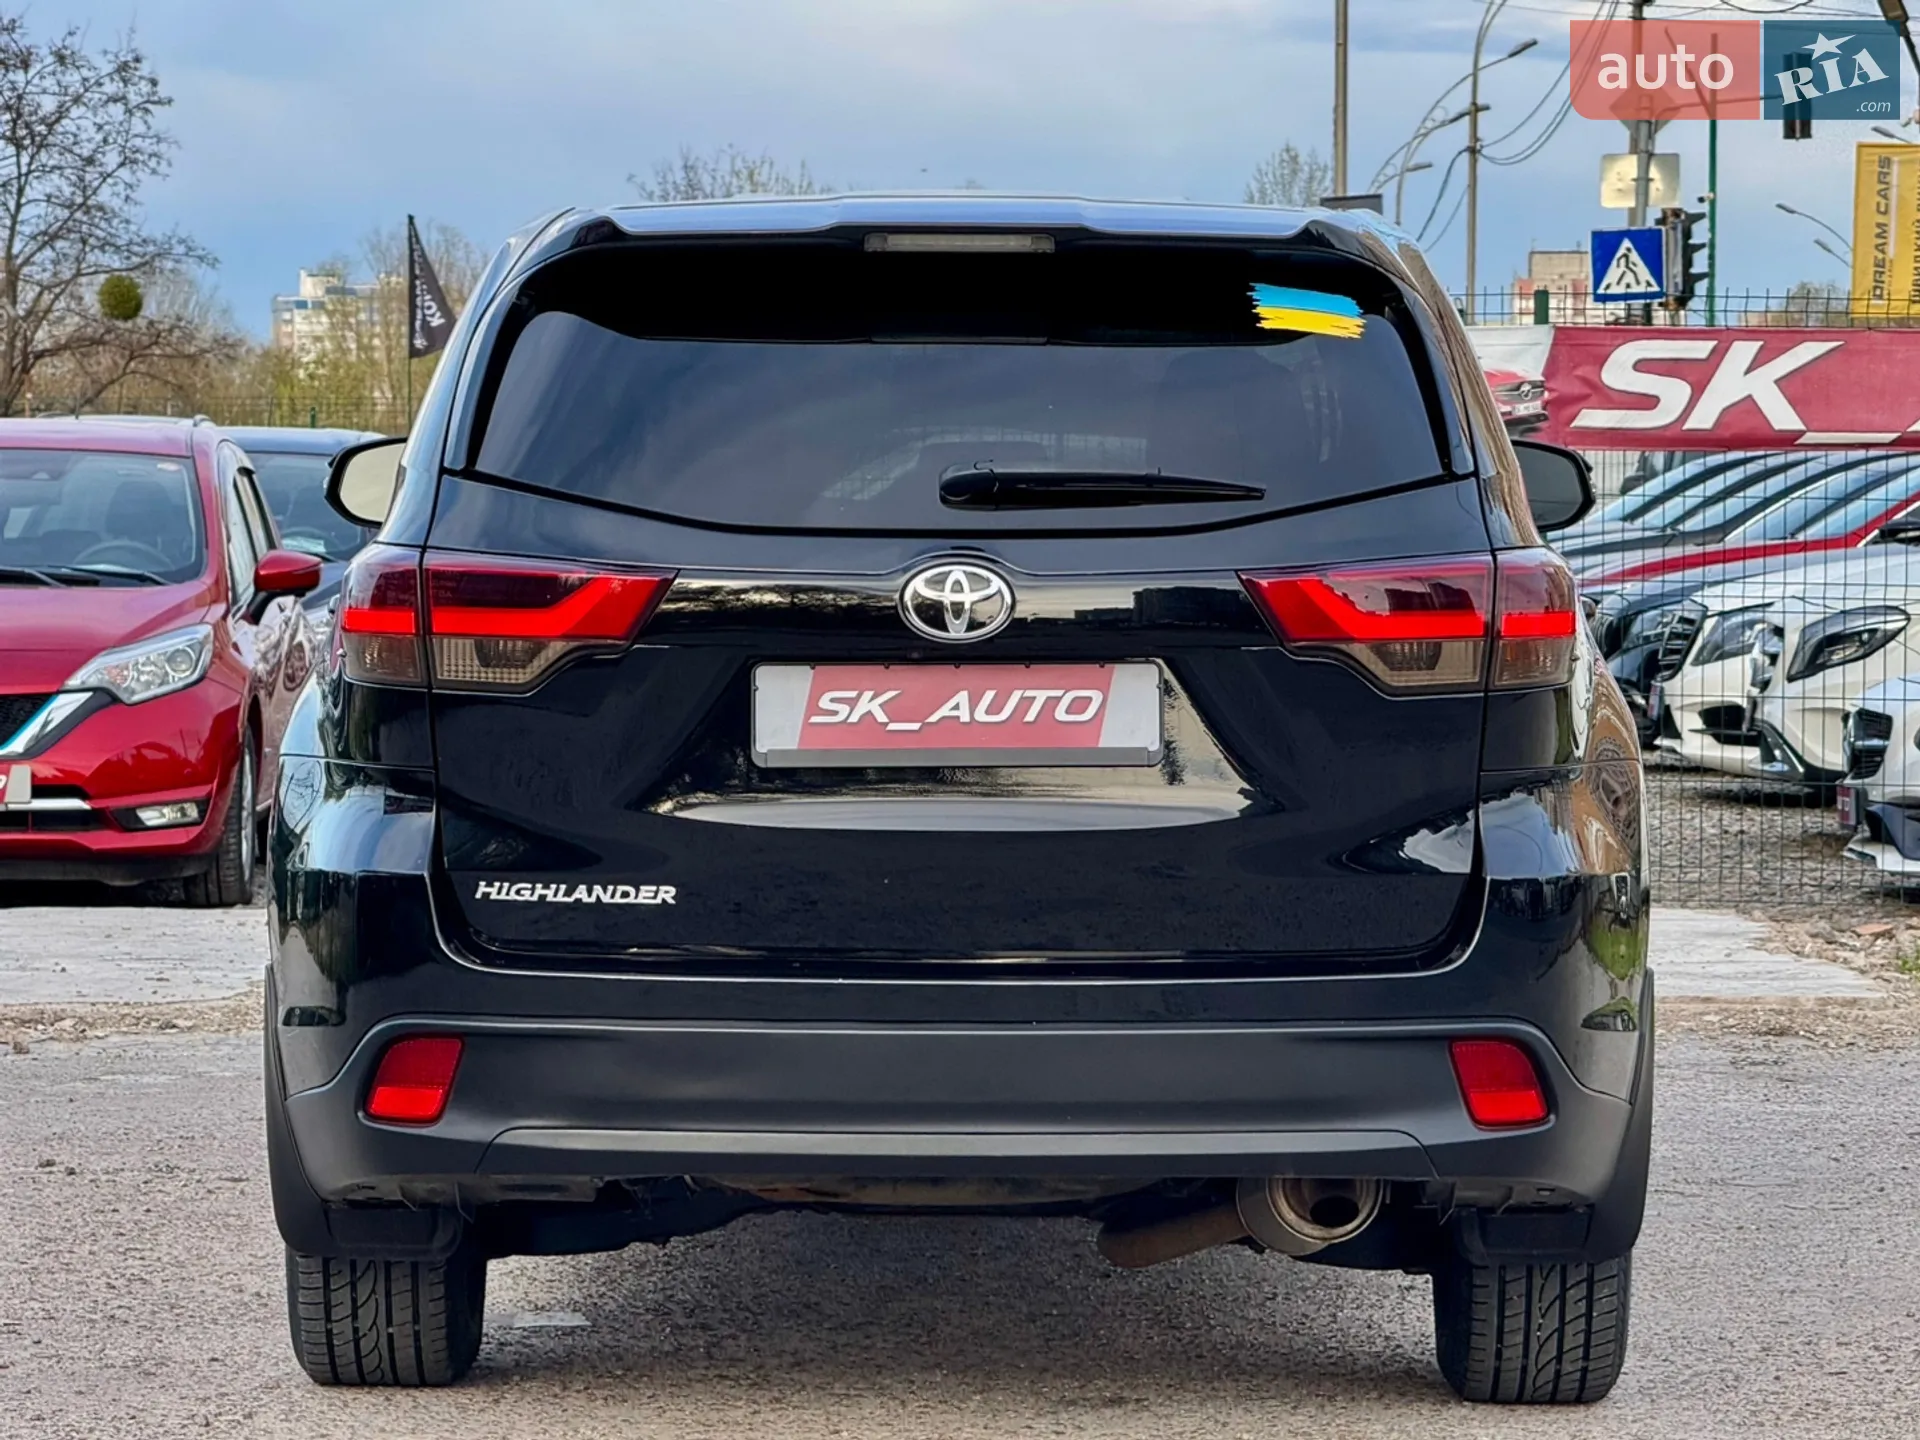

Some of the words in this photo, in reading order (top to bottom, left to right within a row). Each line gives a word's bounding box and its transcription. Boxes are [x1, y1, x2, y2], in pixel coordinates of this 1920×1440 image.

[1876, 155, 1892, 215] CARS
[1872, 222, 1889, 300] DREAM
[1570, 339, 1920, 444] SK_
[808, 689, 1104, 731] SK_AUTO
[475, 881, 676, 904] HIGHLANDER
